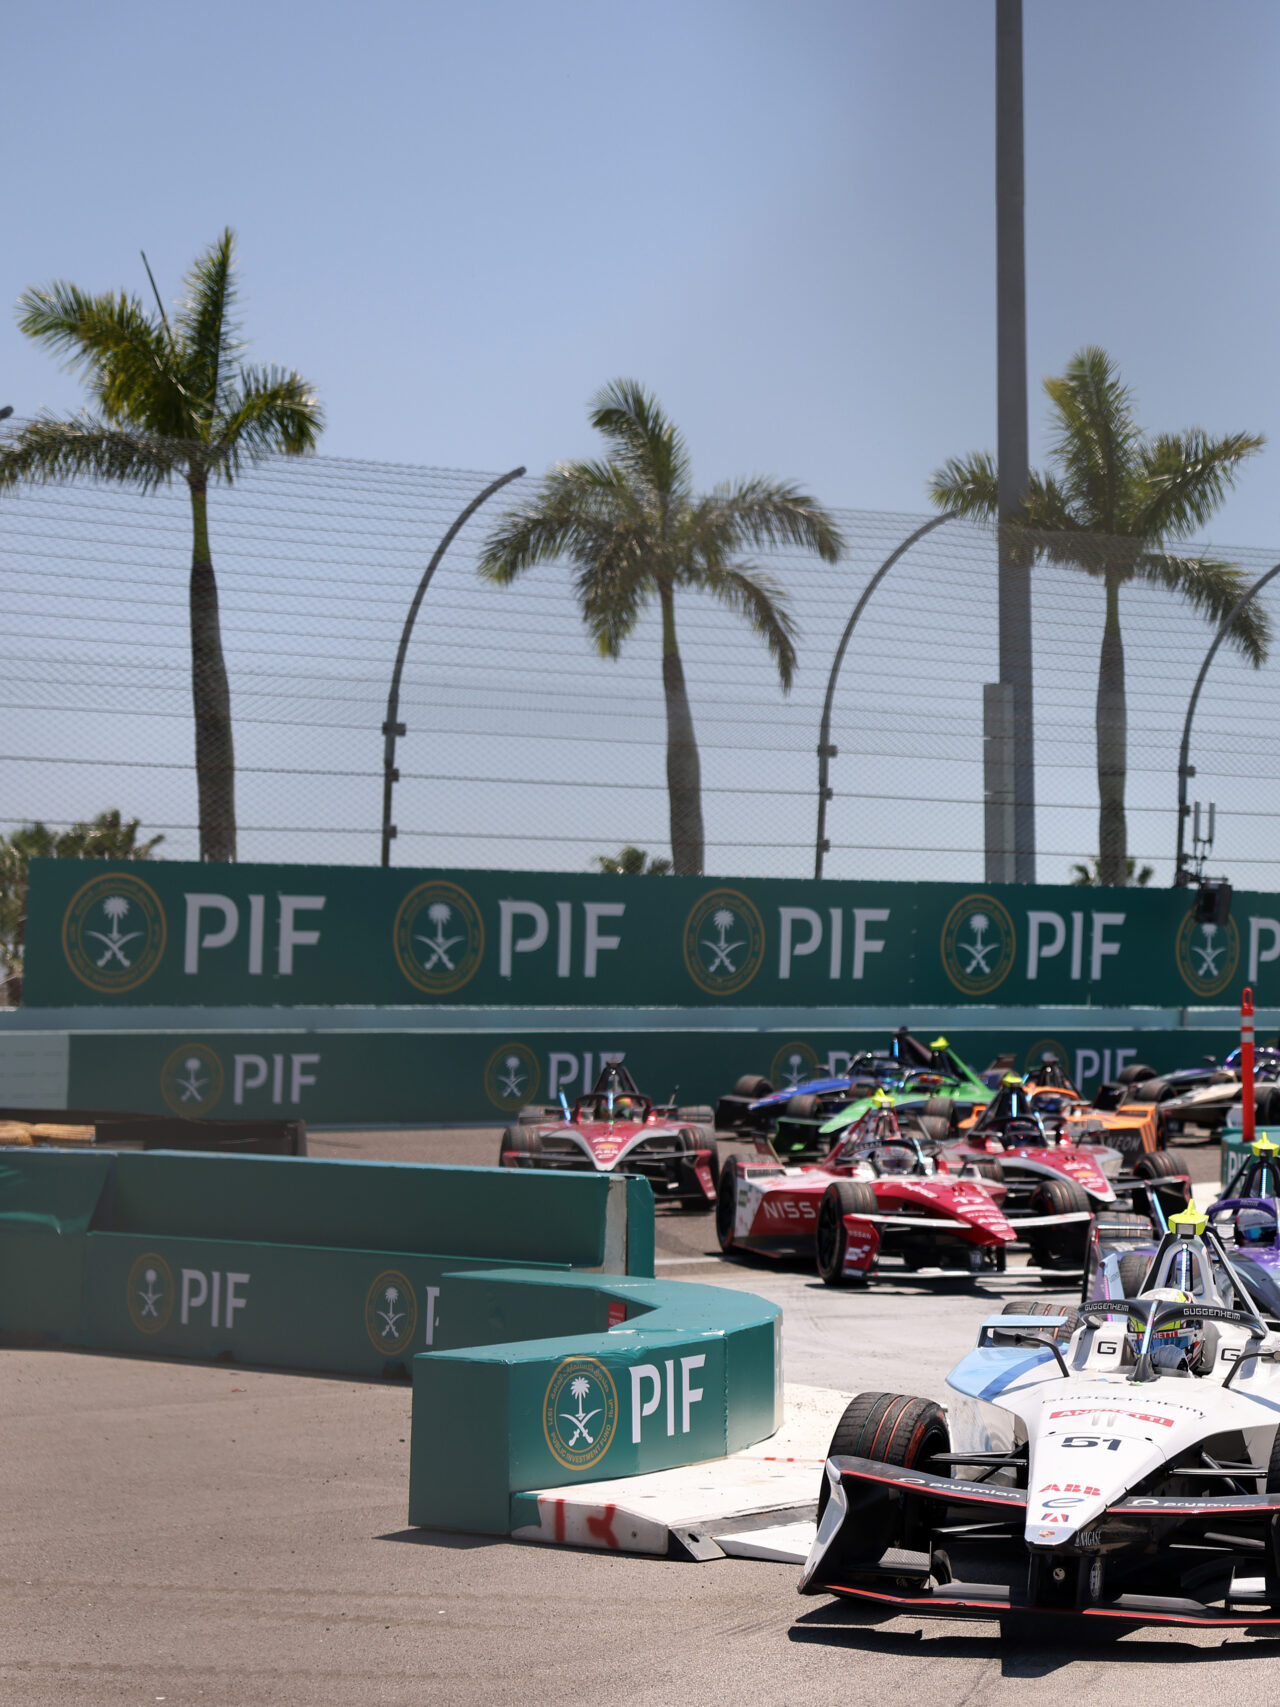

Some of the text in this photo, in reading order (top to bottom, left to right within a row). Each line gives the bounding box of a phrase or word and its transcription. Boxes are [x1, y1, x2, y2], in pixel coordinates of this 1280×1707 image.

[185, 894, 325, 974] PIF
[499, 901, 625, 977] PIF
[779, 907, 890, 978] PIF
[1028, 912, 1125, 979] PIF
[235, 1054, 320, 1104] PIF
[762, 1200, 820, 1219] NISS
[182, 1269, 249, 1328] PIF
[1084, 1302, 1130, 1312] GUGGENHEIM
[1183, 1308, 1241, 1321] GUGGENHEIM
[1097, 1341, 1117, 1355] G
[1221, 1348, 1241, 1361] G
[629, 1354, 705, 1443] PIF
[1061, 1436, 1122, 1451] 51
[929, 1482, 1021, 1498] prysmian
[1038, 1484, 1101, 1496] ABB
